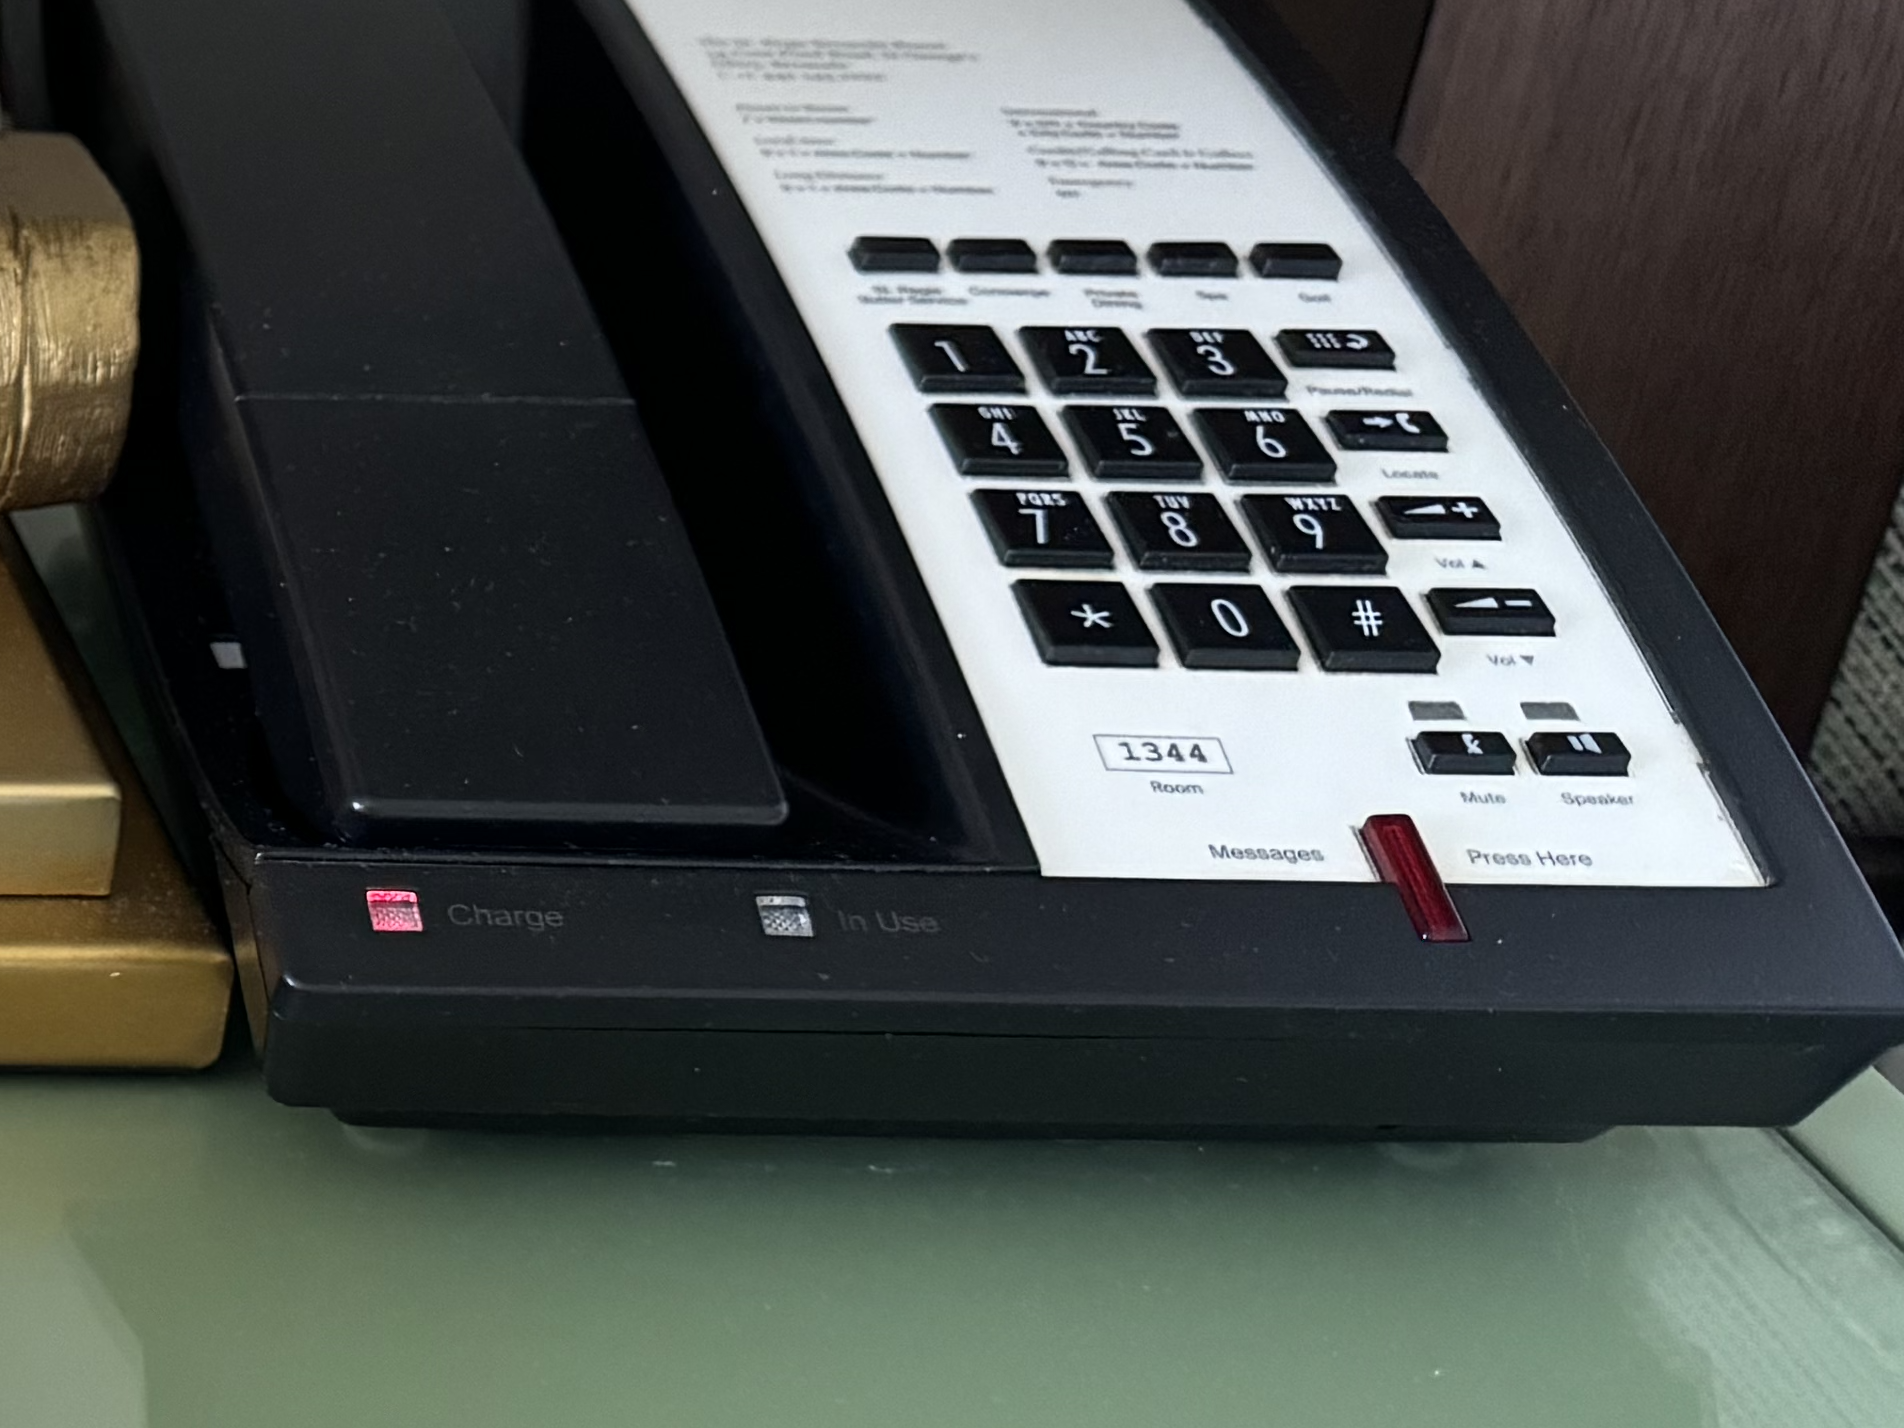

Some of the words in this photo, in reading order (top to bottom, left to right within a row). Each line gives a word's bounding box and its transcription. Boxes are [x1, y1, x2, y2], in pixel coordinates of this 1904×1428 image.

[1064, 329, 1099, 344] ABC
[1189, 330, 1224, 344] DEF
[934, 341, 970, 372] 1
[1069, 344, 1108, 375] 2
[1197, 345, 1234, 376] 3
[1113, 408, 1147, 422] JKL
[1244, 409, 1286, 424] MNO
[991, 422, 1022, 455] 4
[1118, 423, 1153, 456] 5
[1256, 426, 1287, 458] 6
[1016, 492, 1067, 507] PQRS
[1153, 494, 1191, 509] TUV
[1284, 497, 1342, 511] WXYZ
[1019, 509, 1049, 545] 7
[1160, 512, 1198, 548] 8
[1293, 515, 1326, 550] 9
[1210, 598, 1250, 638] 0
[1119, 742, 1208, 764] 1344
[1150, 780, 1204, 795] Room
[1461, 791, 1506, 805] Mute
[1561, 791, 1635, 808] Speaker
[1208, 844, 1323, 864] Messages
[1467, 849, 1531, 866] Press
[1537, 850, 1593, 867] Here
[447, 903, 564, 930] Charge
[839, 910, 866, 932] In
[874, 911, 939, 933] Use
